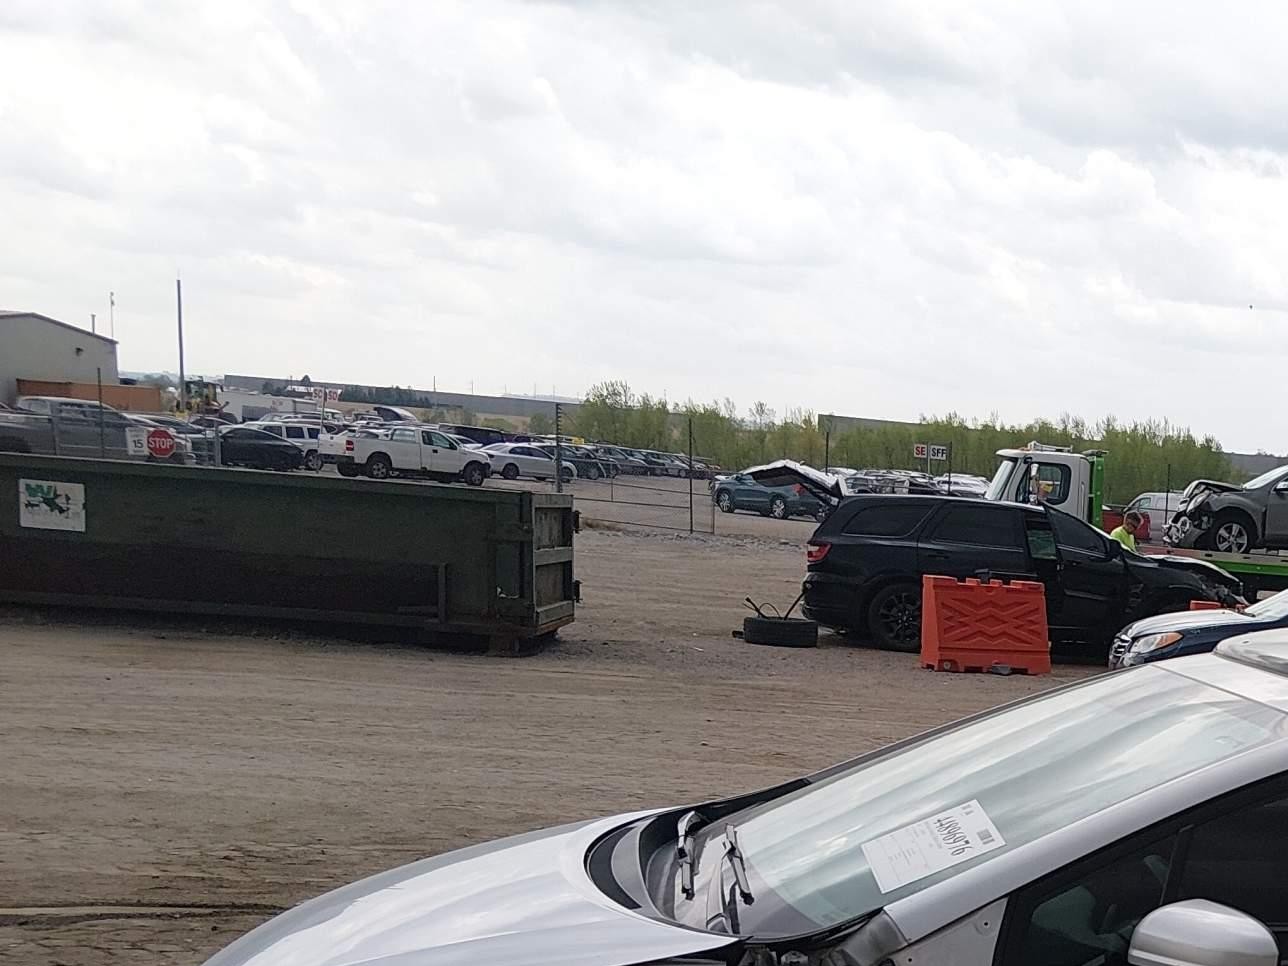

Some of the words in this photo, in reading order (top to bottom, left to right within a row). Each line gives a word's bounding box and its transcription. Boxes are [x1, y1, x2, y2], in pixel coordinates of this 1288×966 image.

[133, 439, 144, 449] 15
[148, 437, 173, 449] STOP
[915, 446, 926, 456] SE
[931, 447, 946, 458] SFF
[933, 815, 973, 856] 44896976
